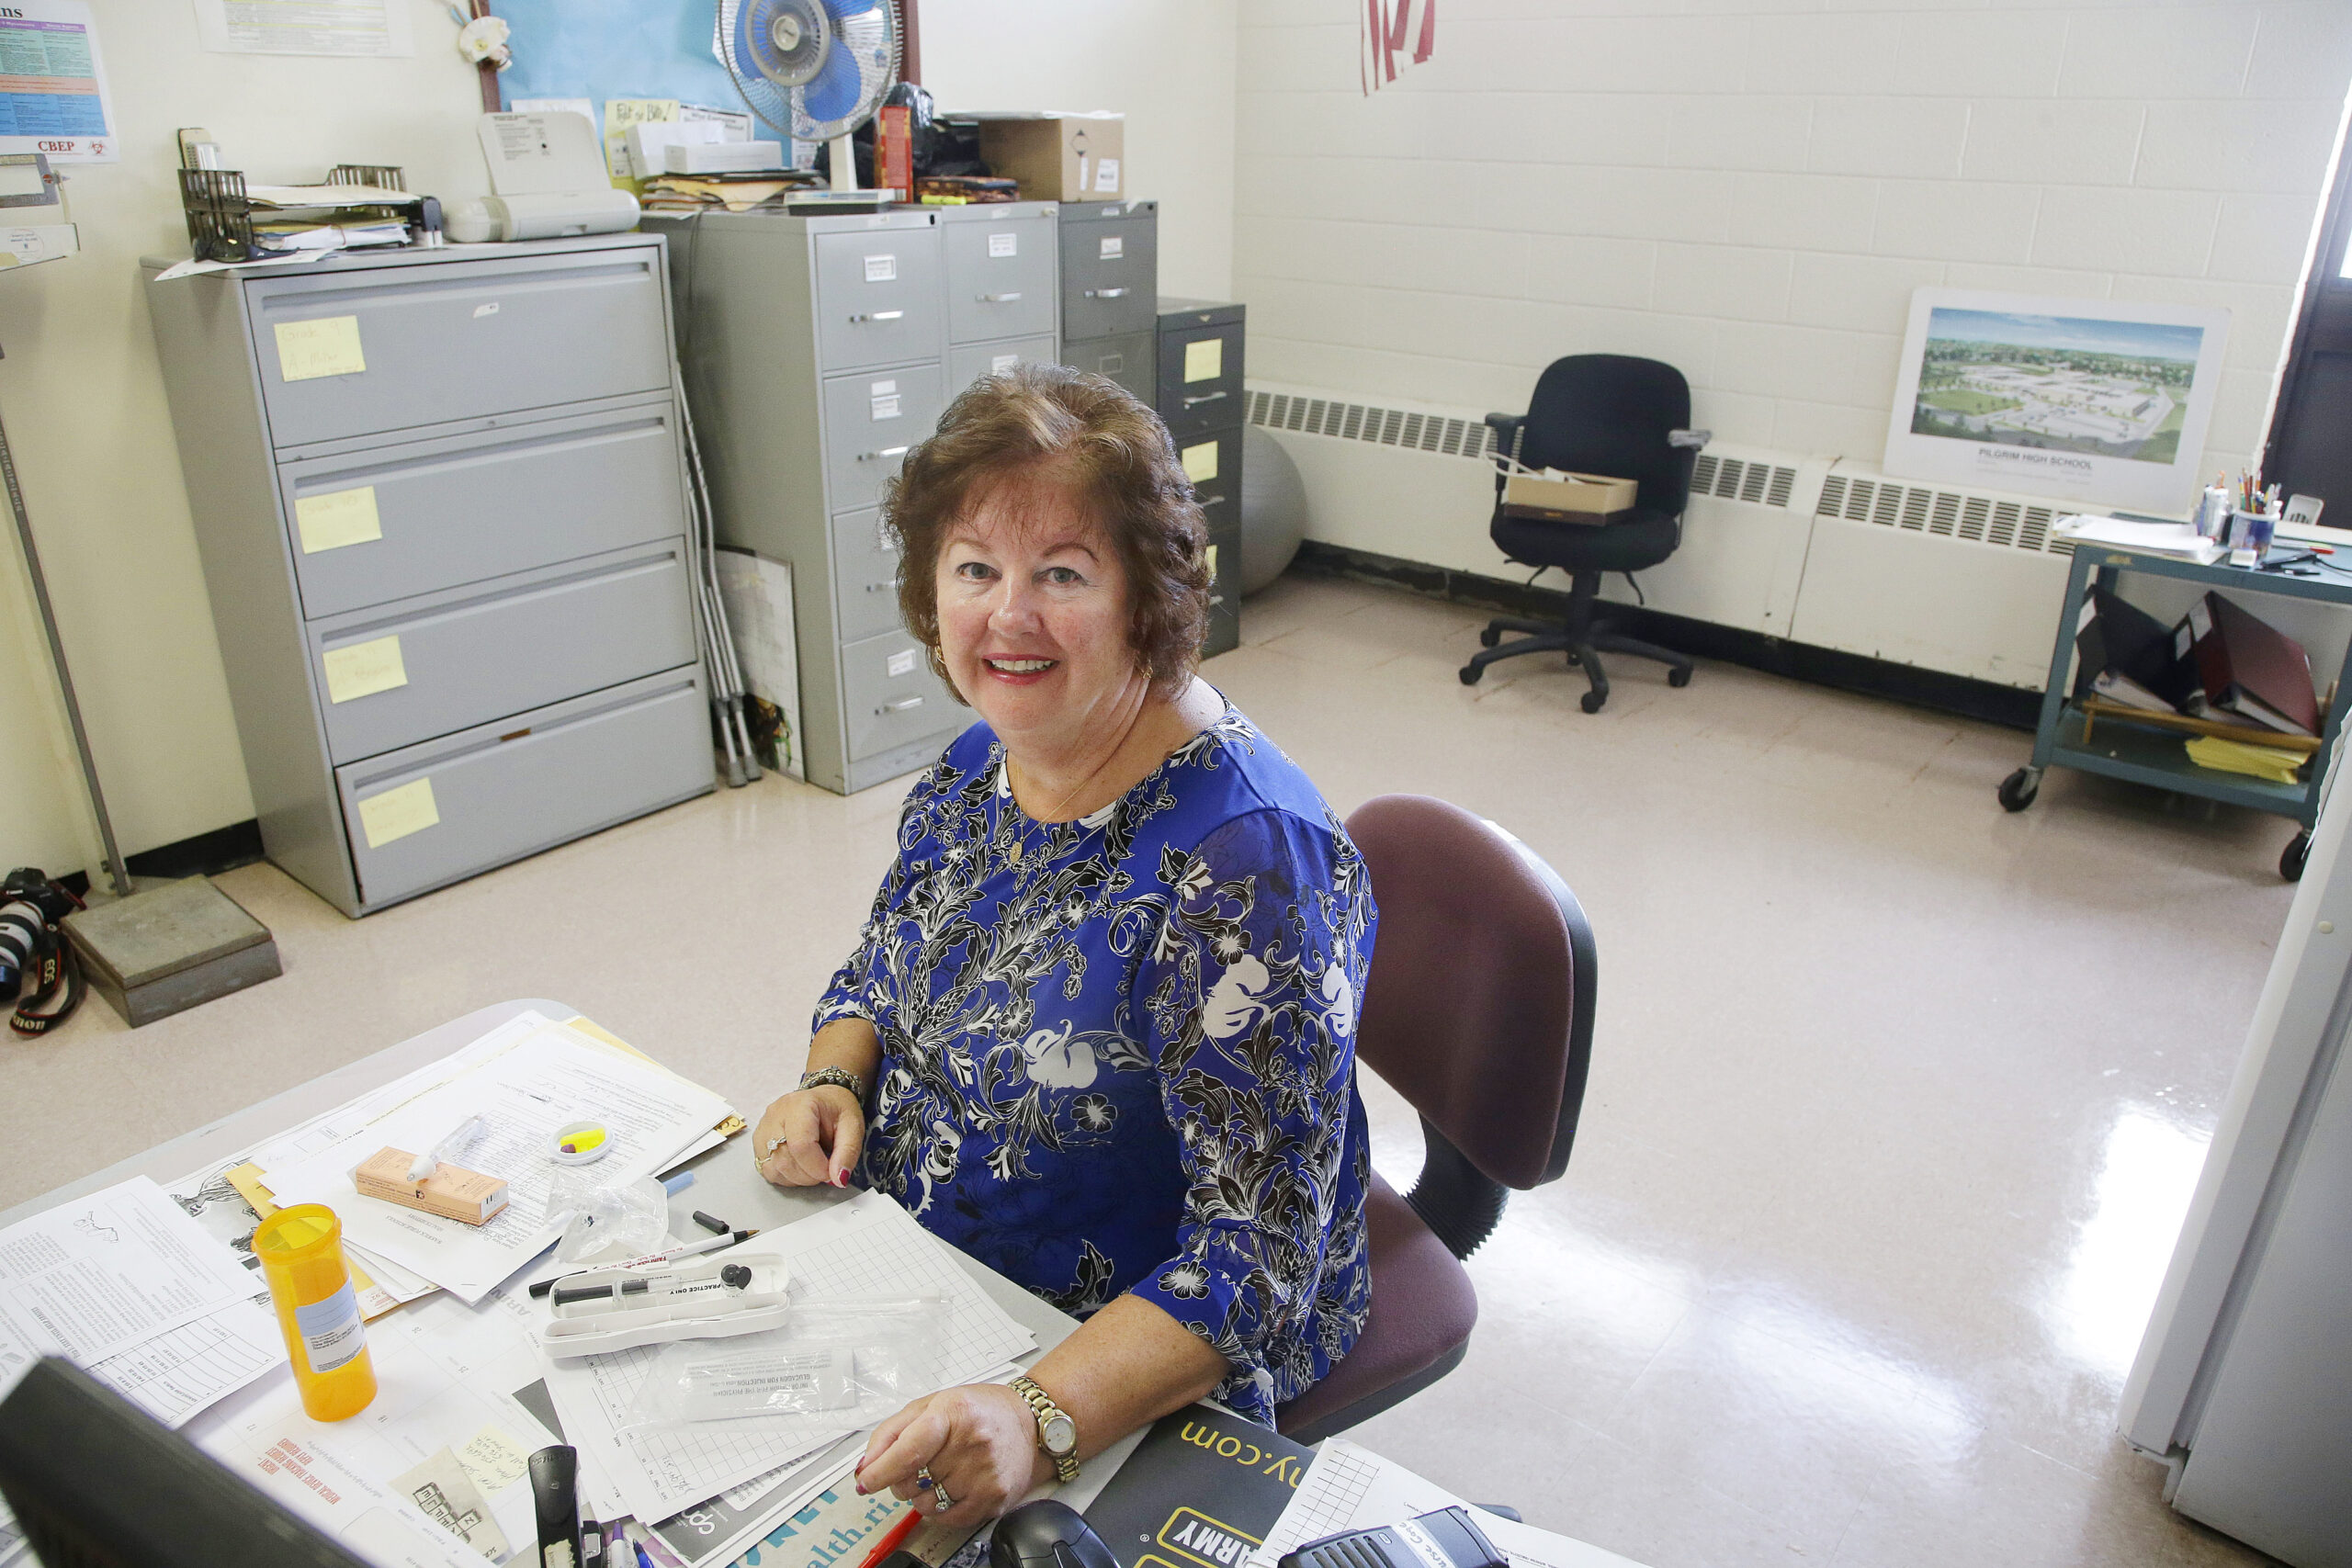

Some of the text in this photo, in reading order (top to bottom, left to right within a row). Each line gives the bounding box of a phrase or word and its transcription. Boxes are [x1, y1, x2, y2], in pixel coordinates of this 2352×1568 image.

[0, 7, 23, 18] ns
[38, 141, 75, 152] CBEP
[1978, 447, 2093, 470] PILGRIM HIGH SCHOOL
[44, 958, 56, 985] EOS
[12, 1014, 46, 1031] anon
[689, 1283, 721, 1293] PRACTICE
[737, 1378, 766, 1387] INJECTION
[779, 1373, 810, 1382] GLUCAGON
[807, 1497, 910, 1568] alth.ri.
[1172, 1519, 1259, 1568] ARMY
